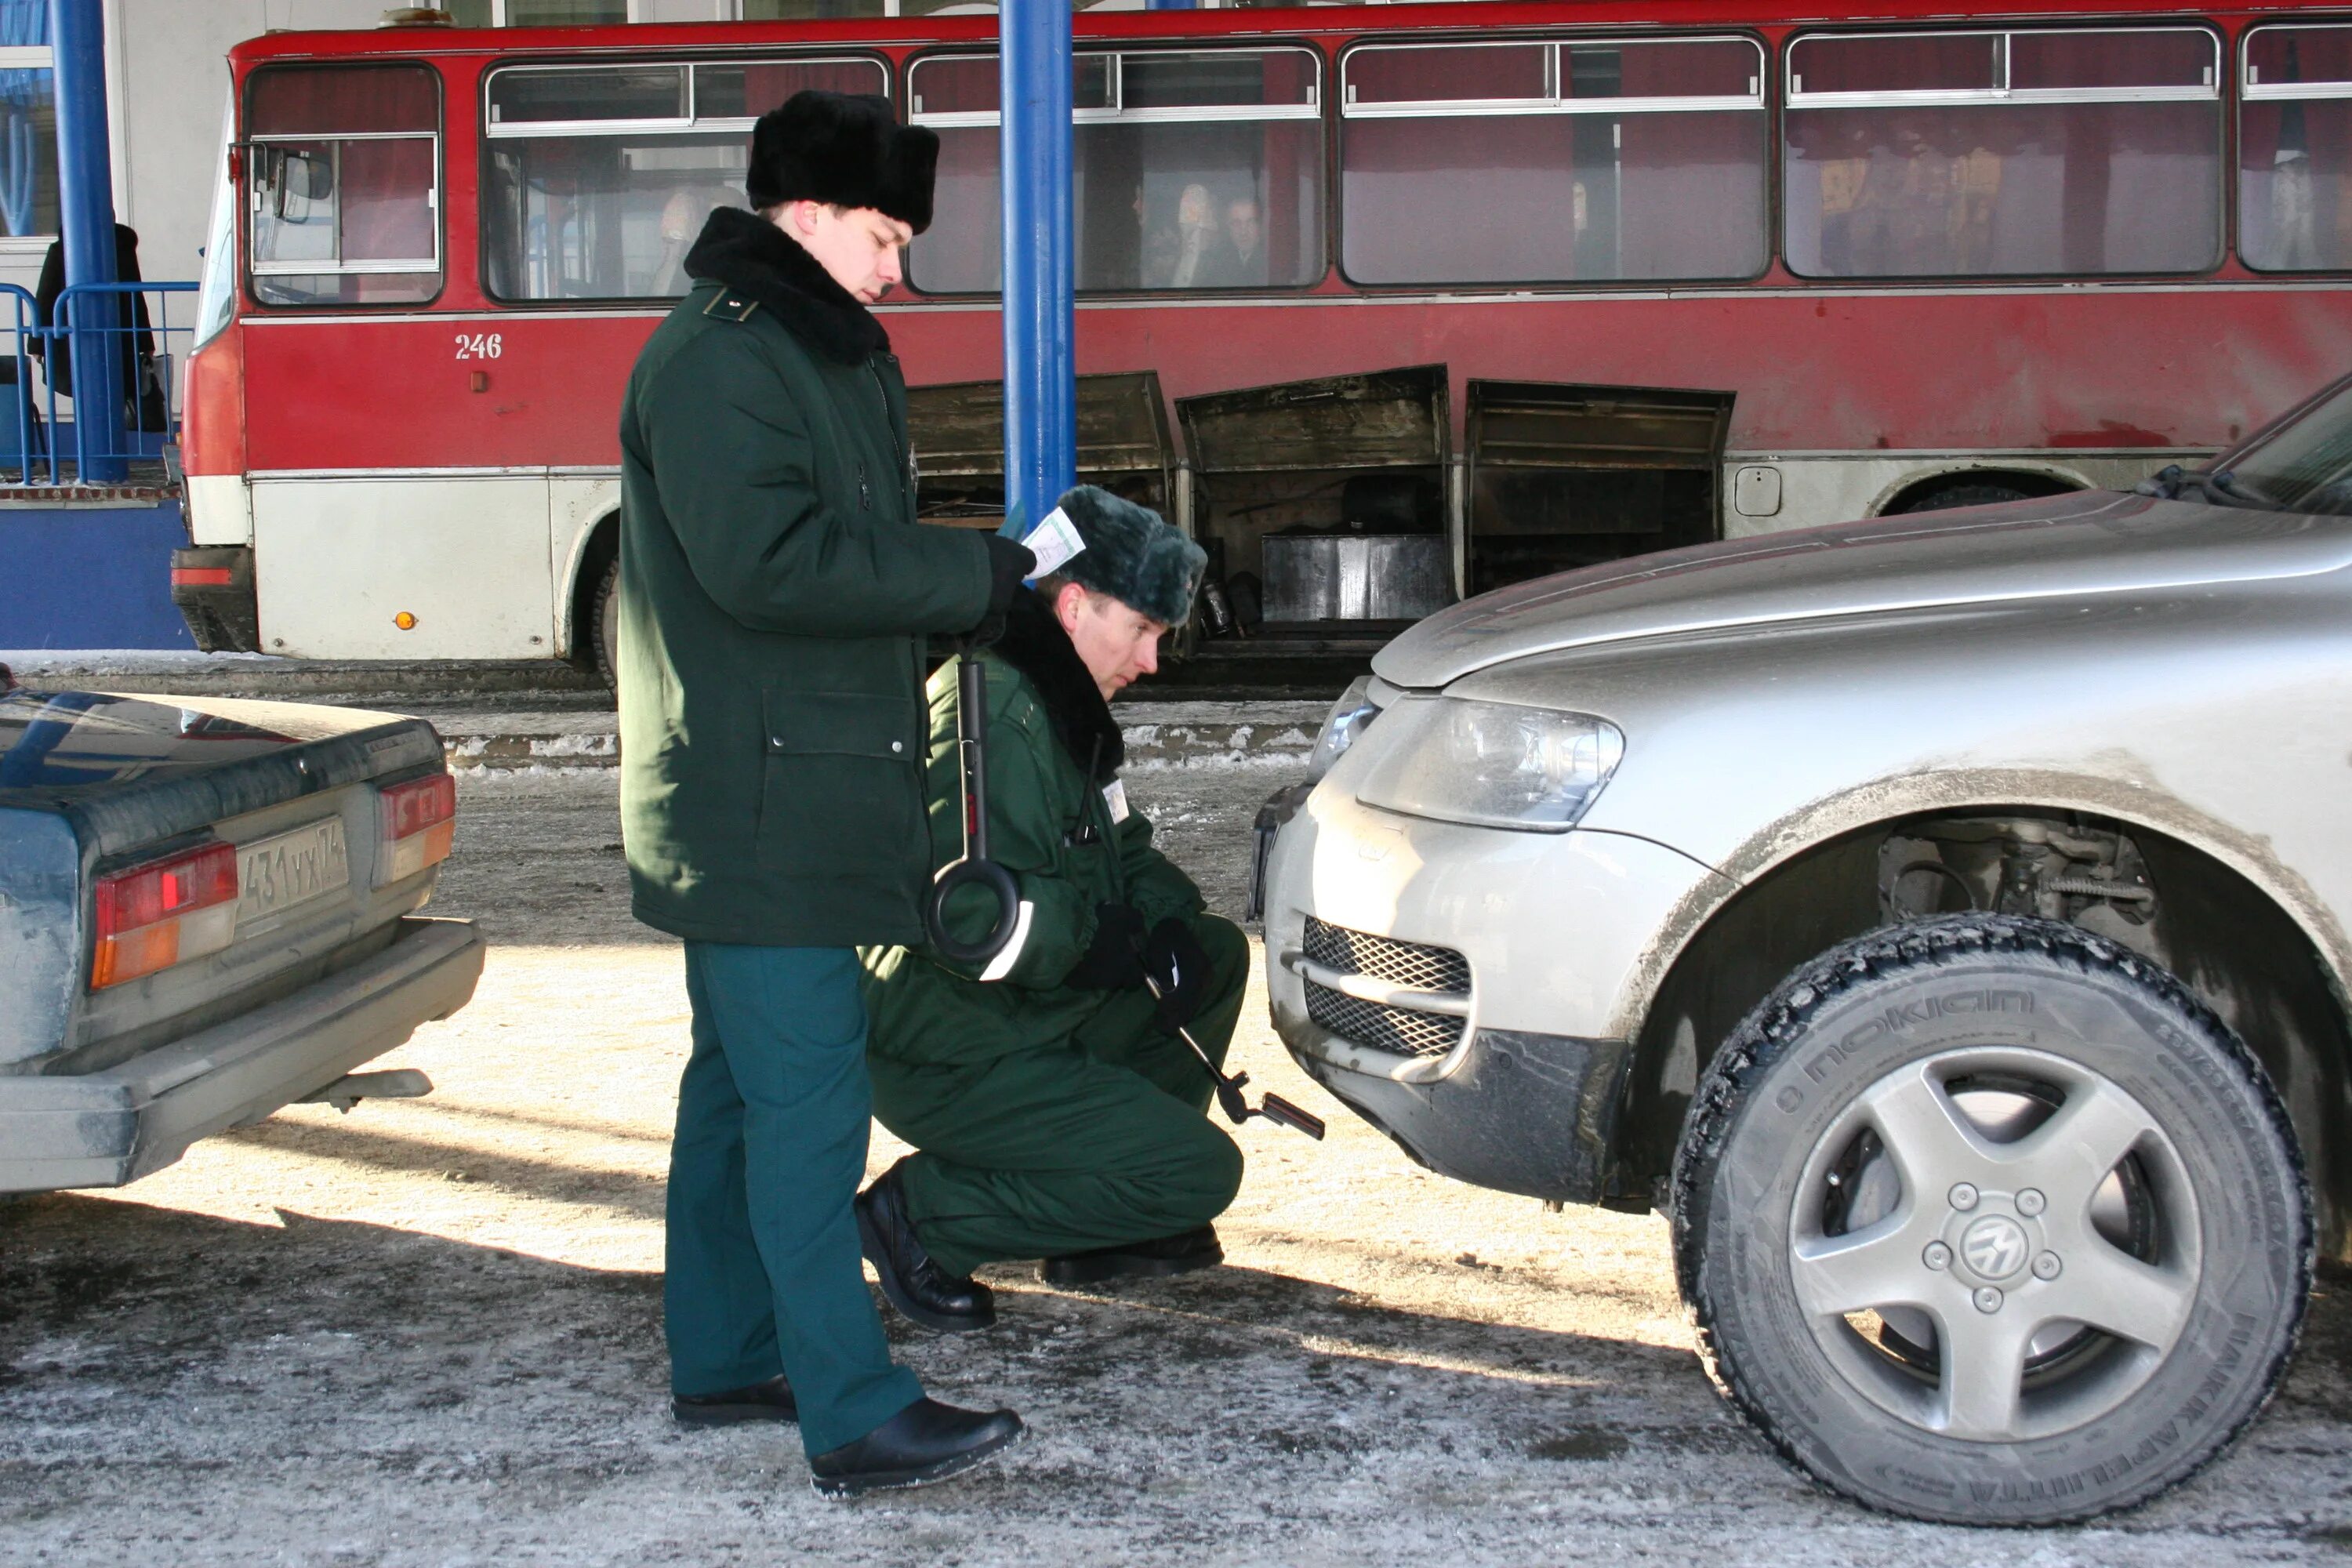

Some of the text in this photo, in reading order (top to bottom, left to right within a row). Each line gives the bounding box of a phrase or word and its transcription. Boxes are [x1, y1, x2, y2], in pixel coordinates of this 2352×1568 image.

[455, 333, 502, 360] 246
[237, 824, 343, 912] 431УХ 74
